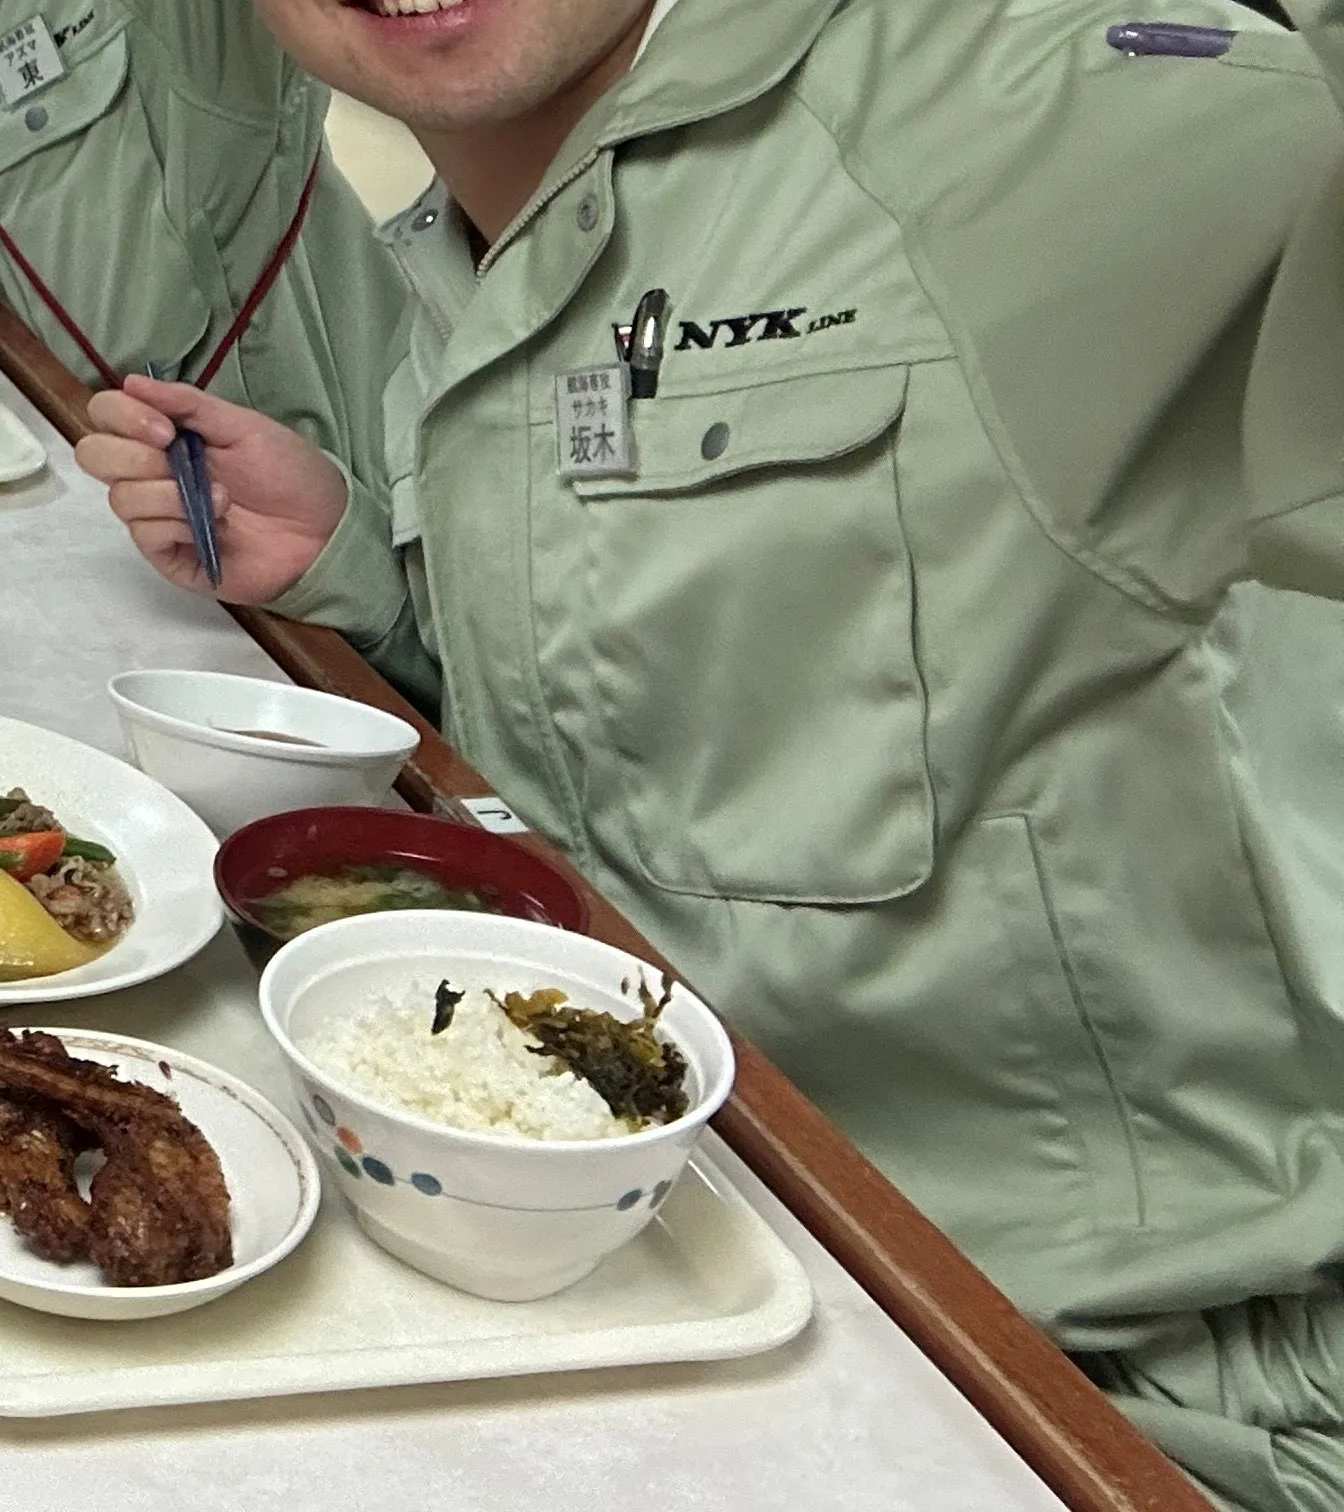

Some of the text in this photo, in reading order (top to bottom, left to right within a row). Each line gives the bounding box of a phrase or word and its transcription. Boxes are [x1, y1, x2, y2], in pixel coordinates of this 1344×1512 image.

[18, 58, 44, 89] 東
[673, 306, 858, 351] NYK LINE
[570, 423, 615, 464] 坂木
